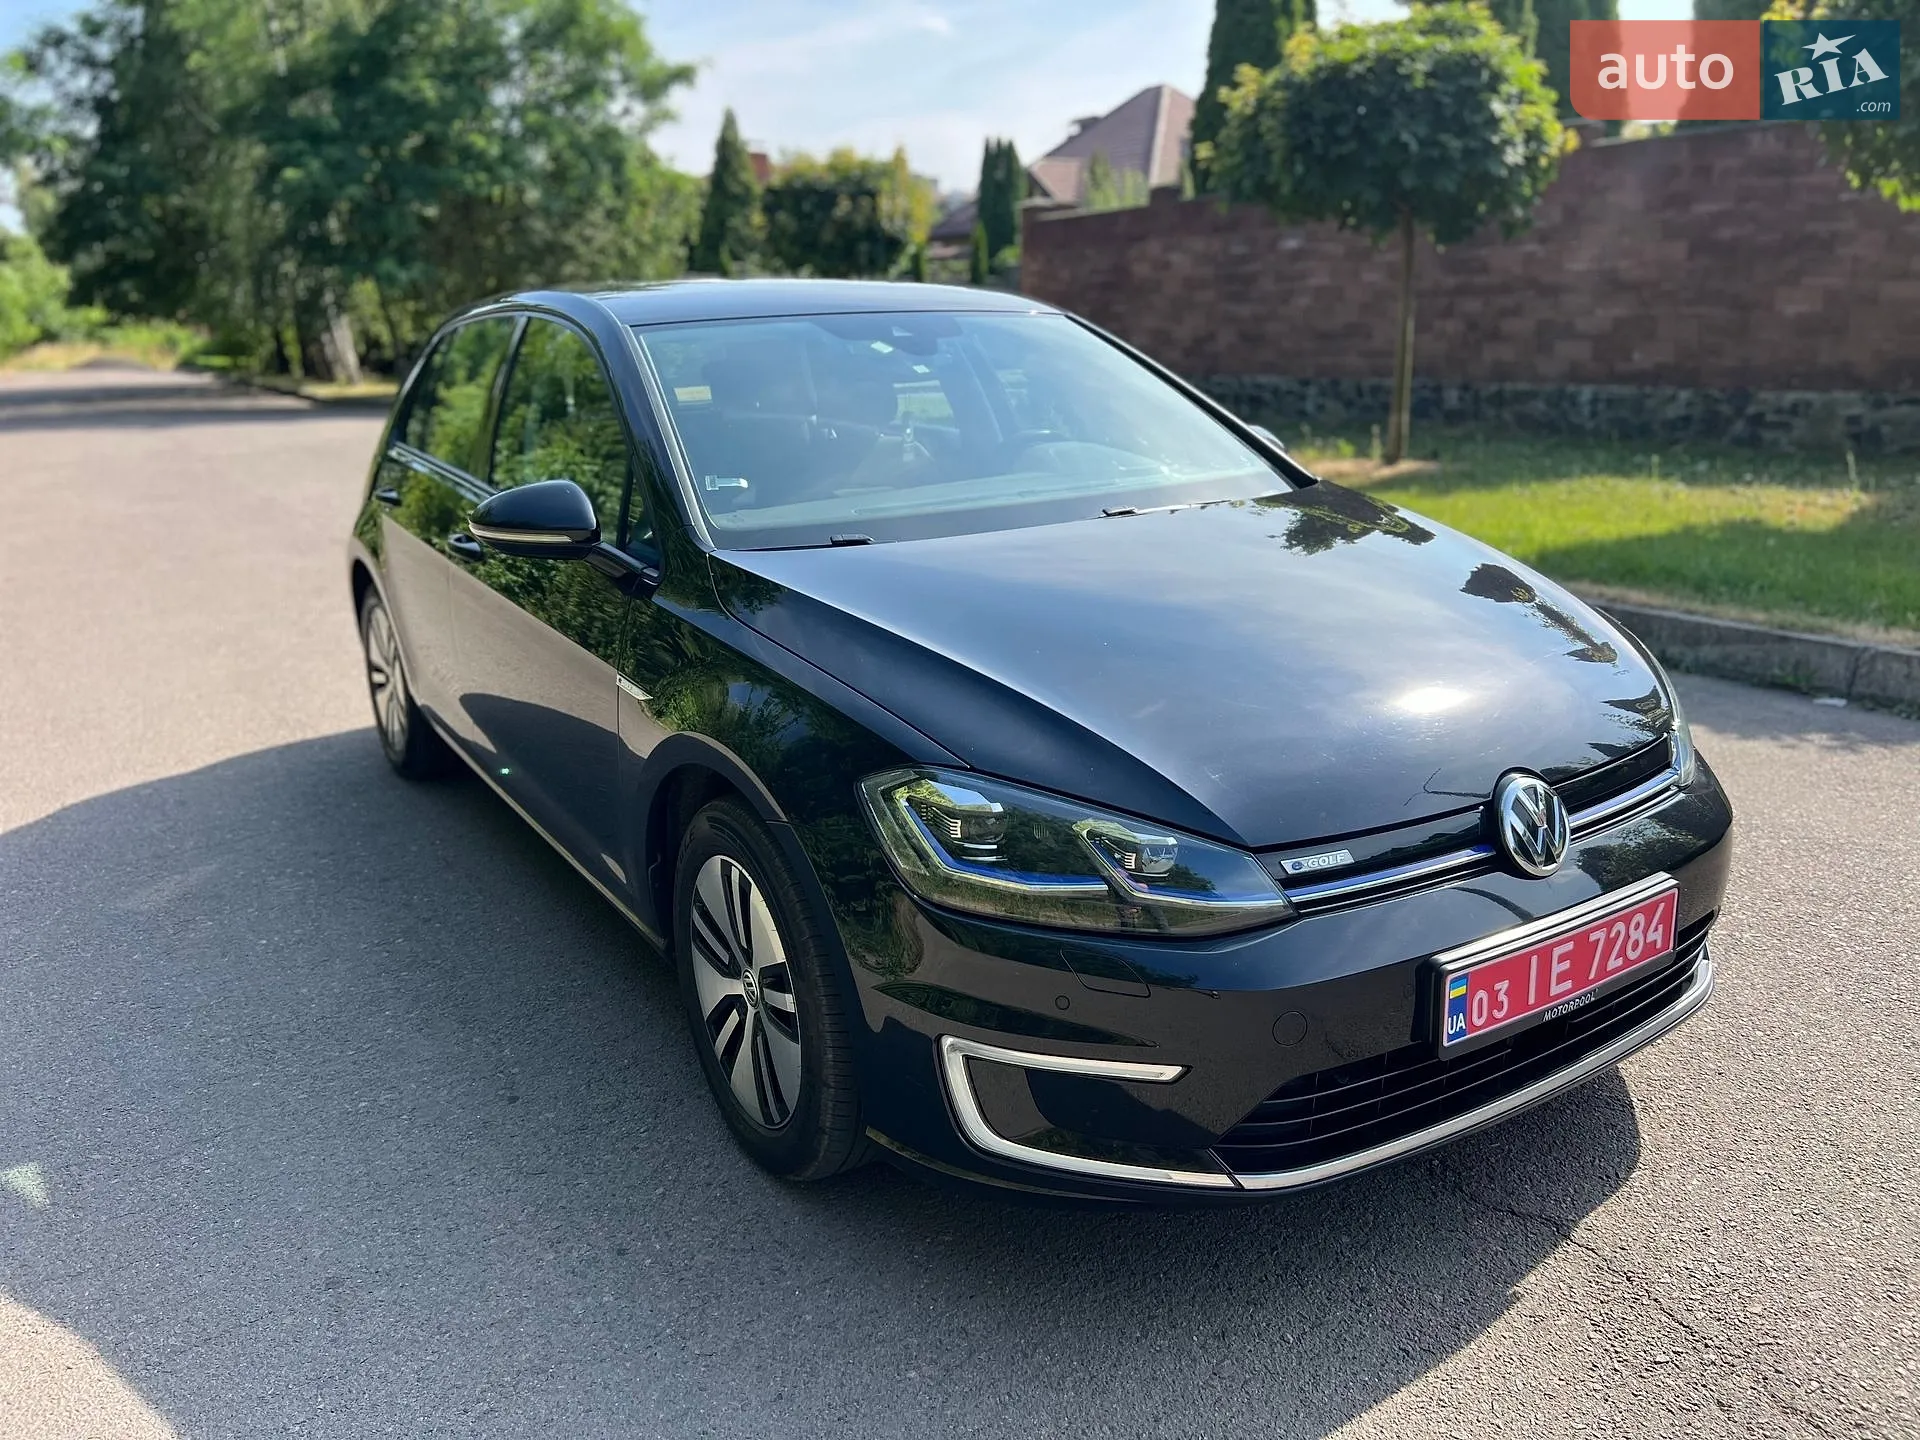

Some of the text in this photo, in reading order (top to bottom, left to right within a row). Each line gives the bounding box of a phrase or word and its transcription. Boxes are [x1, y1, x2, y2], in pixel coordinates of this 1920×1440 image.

[1471, 902, 1665, 1027] 03 IE 7284
[1542, 991, 1596, 1022] MOTORPOOL
[1447, 1012, 1466, 1035] UA
